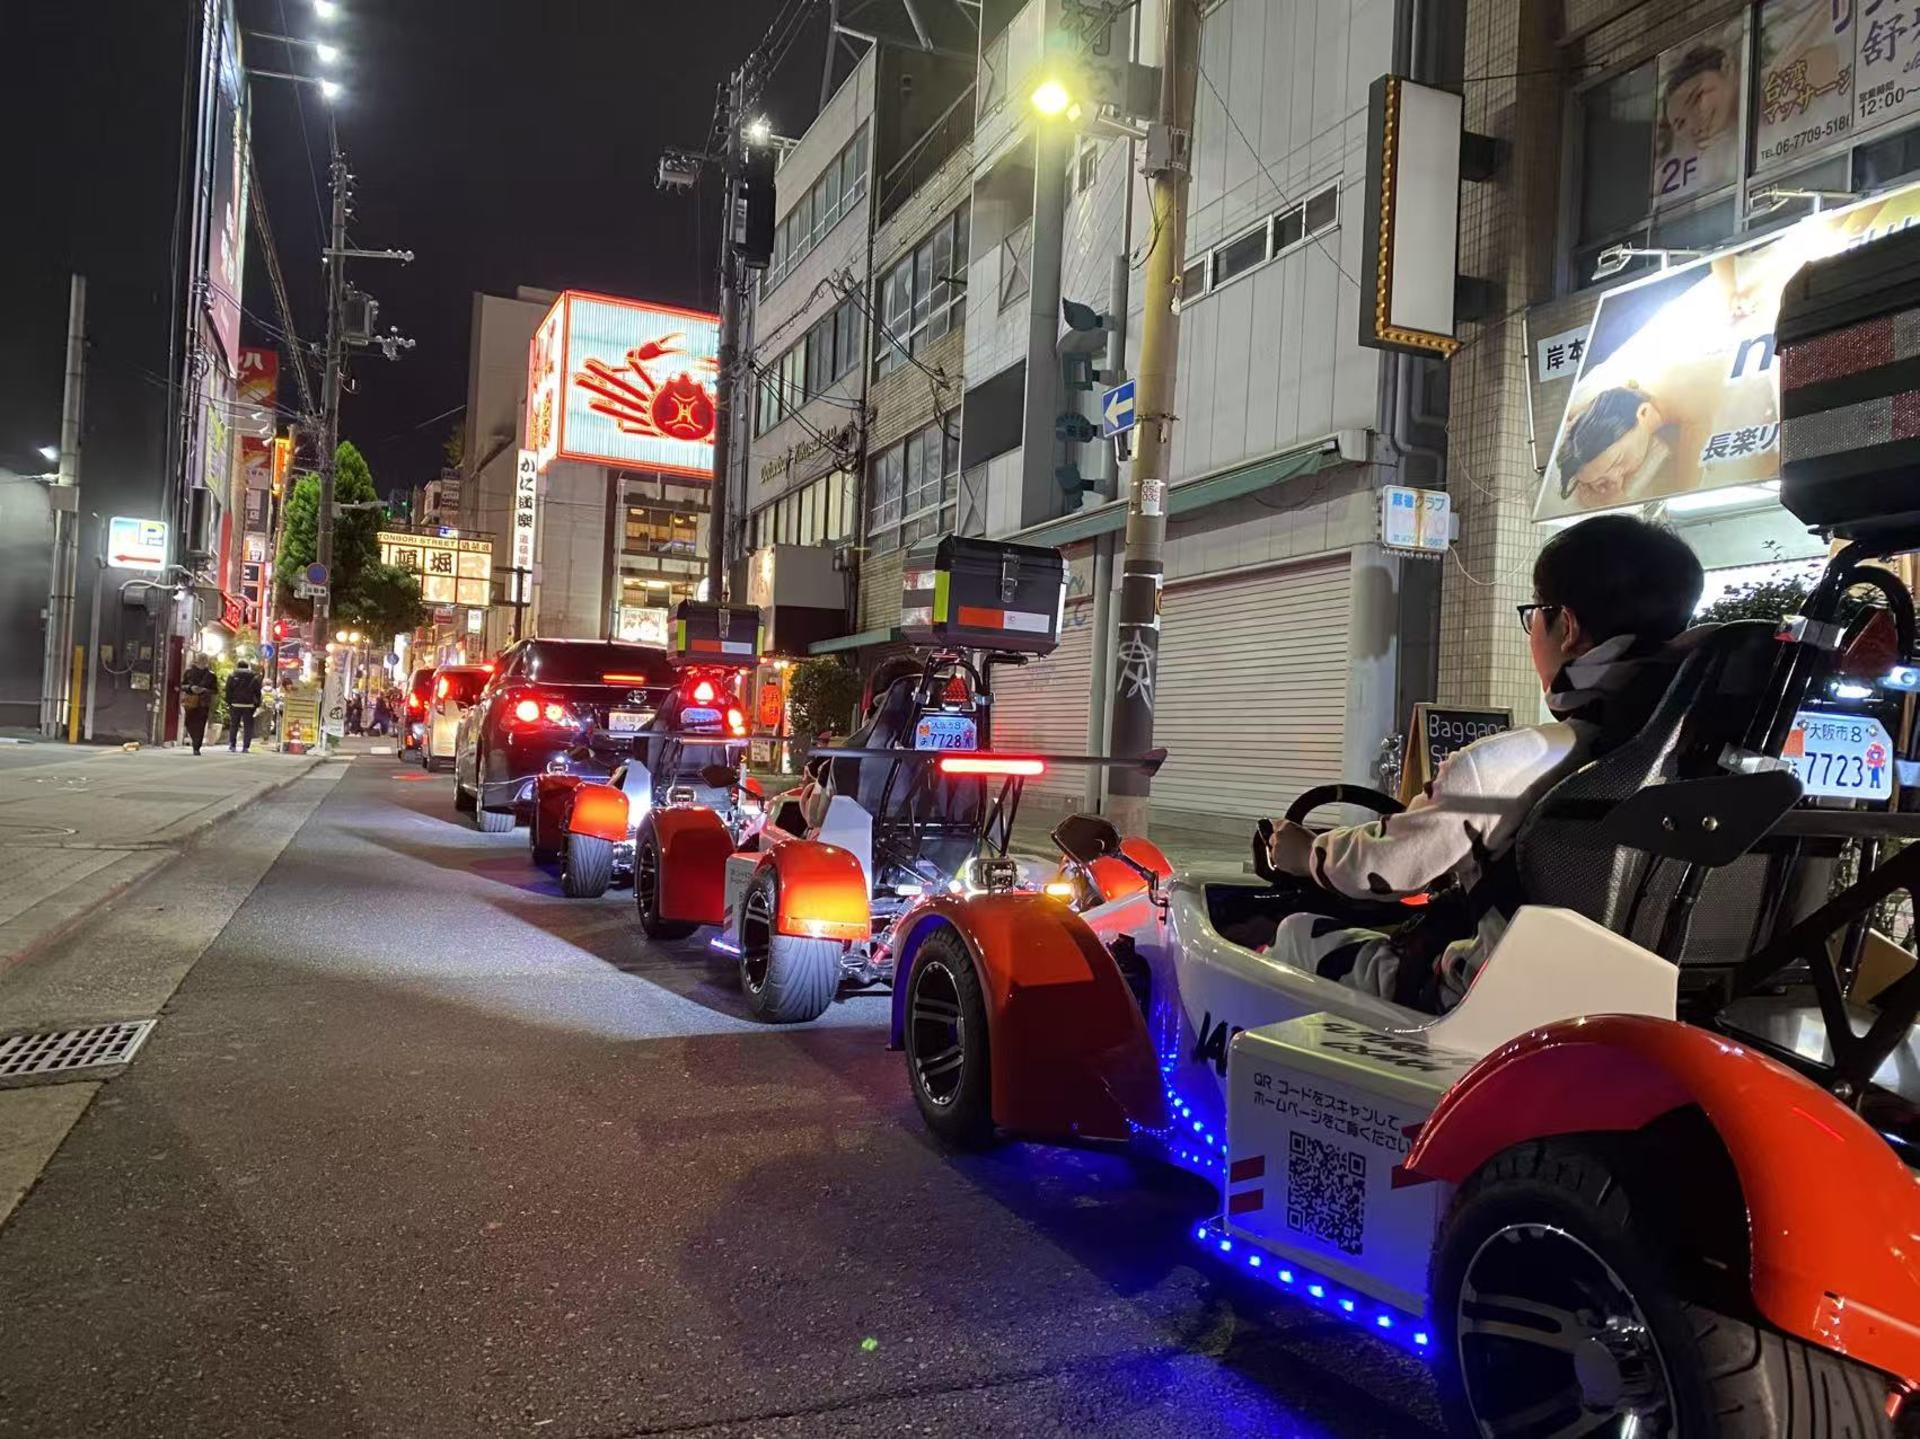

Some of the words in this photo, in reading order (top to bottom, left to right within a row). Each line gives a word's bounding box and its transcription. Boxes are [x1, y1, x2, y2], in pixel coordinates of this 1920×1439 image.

[1763, 64, 1851, 124] マッサージ
[1764, 60, 1807, 102] 台湾
[1661, 156, 1698, 194] 2F
[1546, 338, 1586, 371] 岸本
[518, 457, 536, 528] かに道楽
[419, 537, 456, 547] STREET
[930, 732, 962, 748] 7728
[1804, 751, 1863, 787] 7723
[1254, 1072, 1273, 1090] QR
[1277, 1079, 1401, 1131] コードをスキャンして
